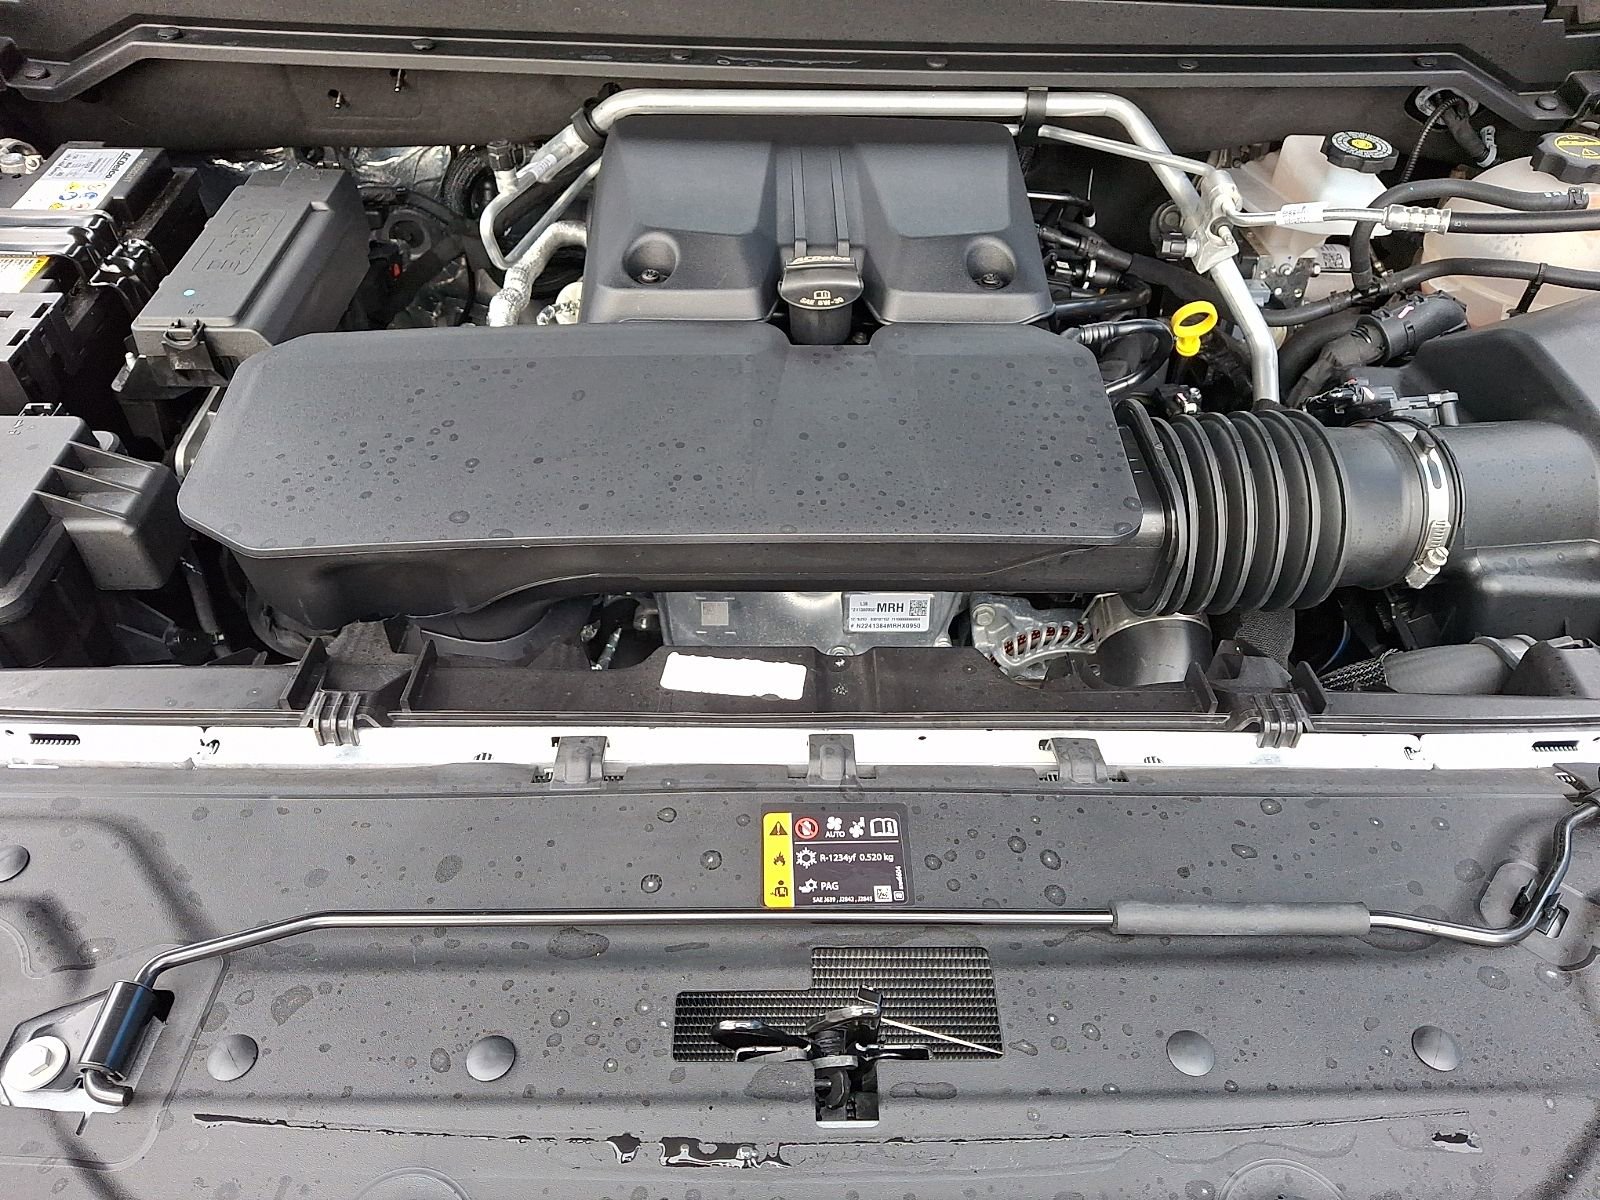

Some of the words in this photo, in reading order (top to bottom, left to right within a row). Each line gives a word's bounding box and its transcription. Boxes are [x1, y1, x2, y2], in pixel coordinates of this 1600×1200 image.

[106, 152, 132, 179] ACDelco
[791, 256, 851, 264] ACDelco
[800, 297, 816, 305] SAE
[877, 602, 904, 613] MRH
[819, 853, 857, 863] R-1234yf
[859, 853, 883, 862] 0.520
[883, 853, 894, 862] kg
[820, 881, 839, 891] PAG
